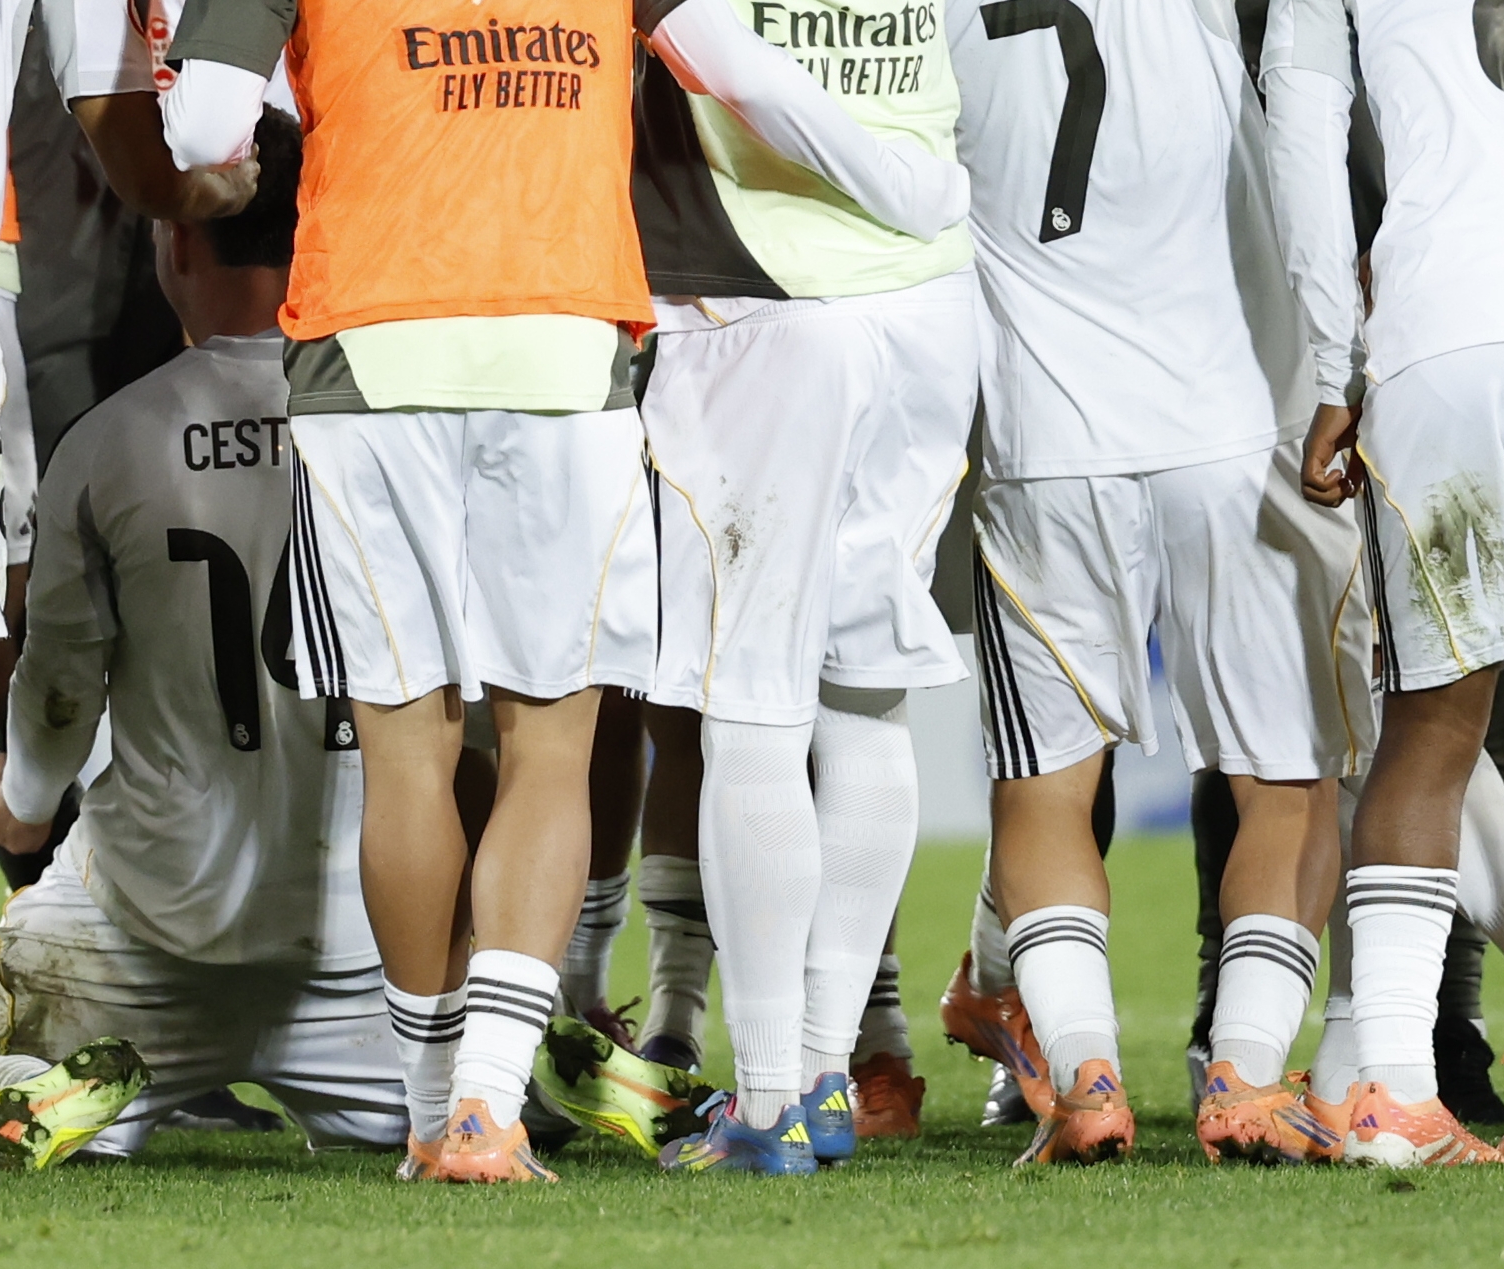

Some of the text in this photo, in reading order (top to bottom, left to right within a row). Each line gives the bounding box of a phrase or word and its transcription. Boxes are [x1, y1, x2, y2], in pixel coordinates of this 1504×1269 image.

[402, 18, 600, 70] Emirates
[750, 1, 937, 48] Emirates
[442, 69, 582, 112] FLY BETTER
[840, 54, 924, 96] BETTER
[183, 417, 288, 471] CEST
